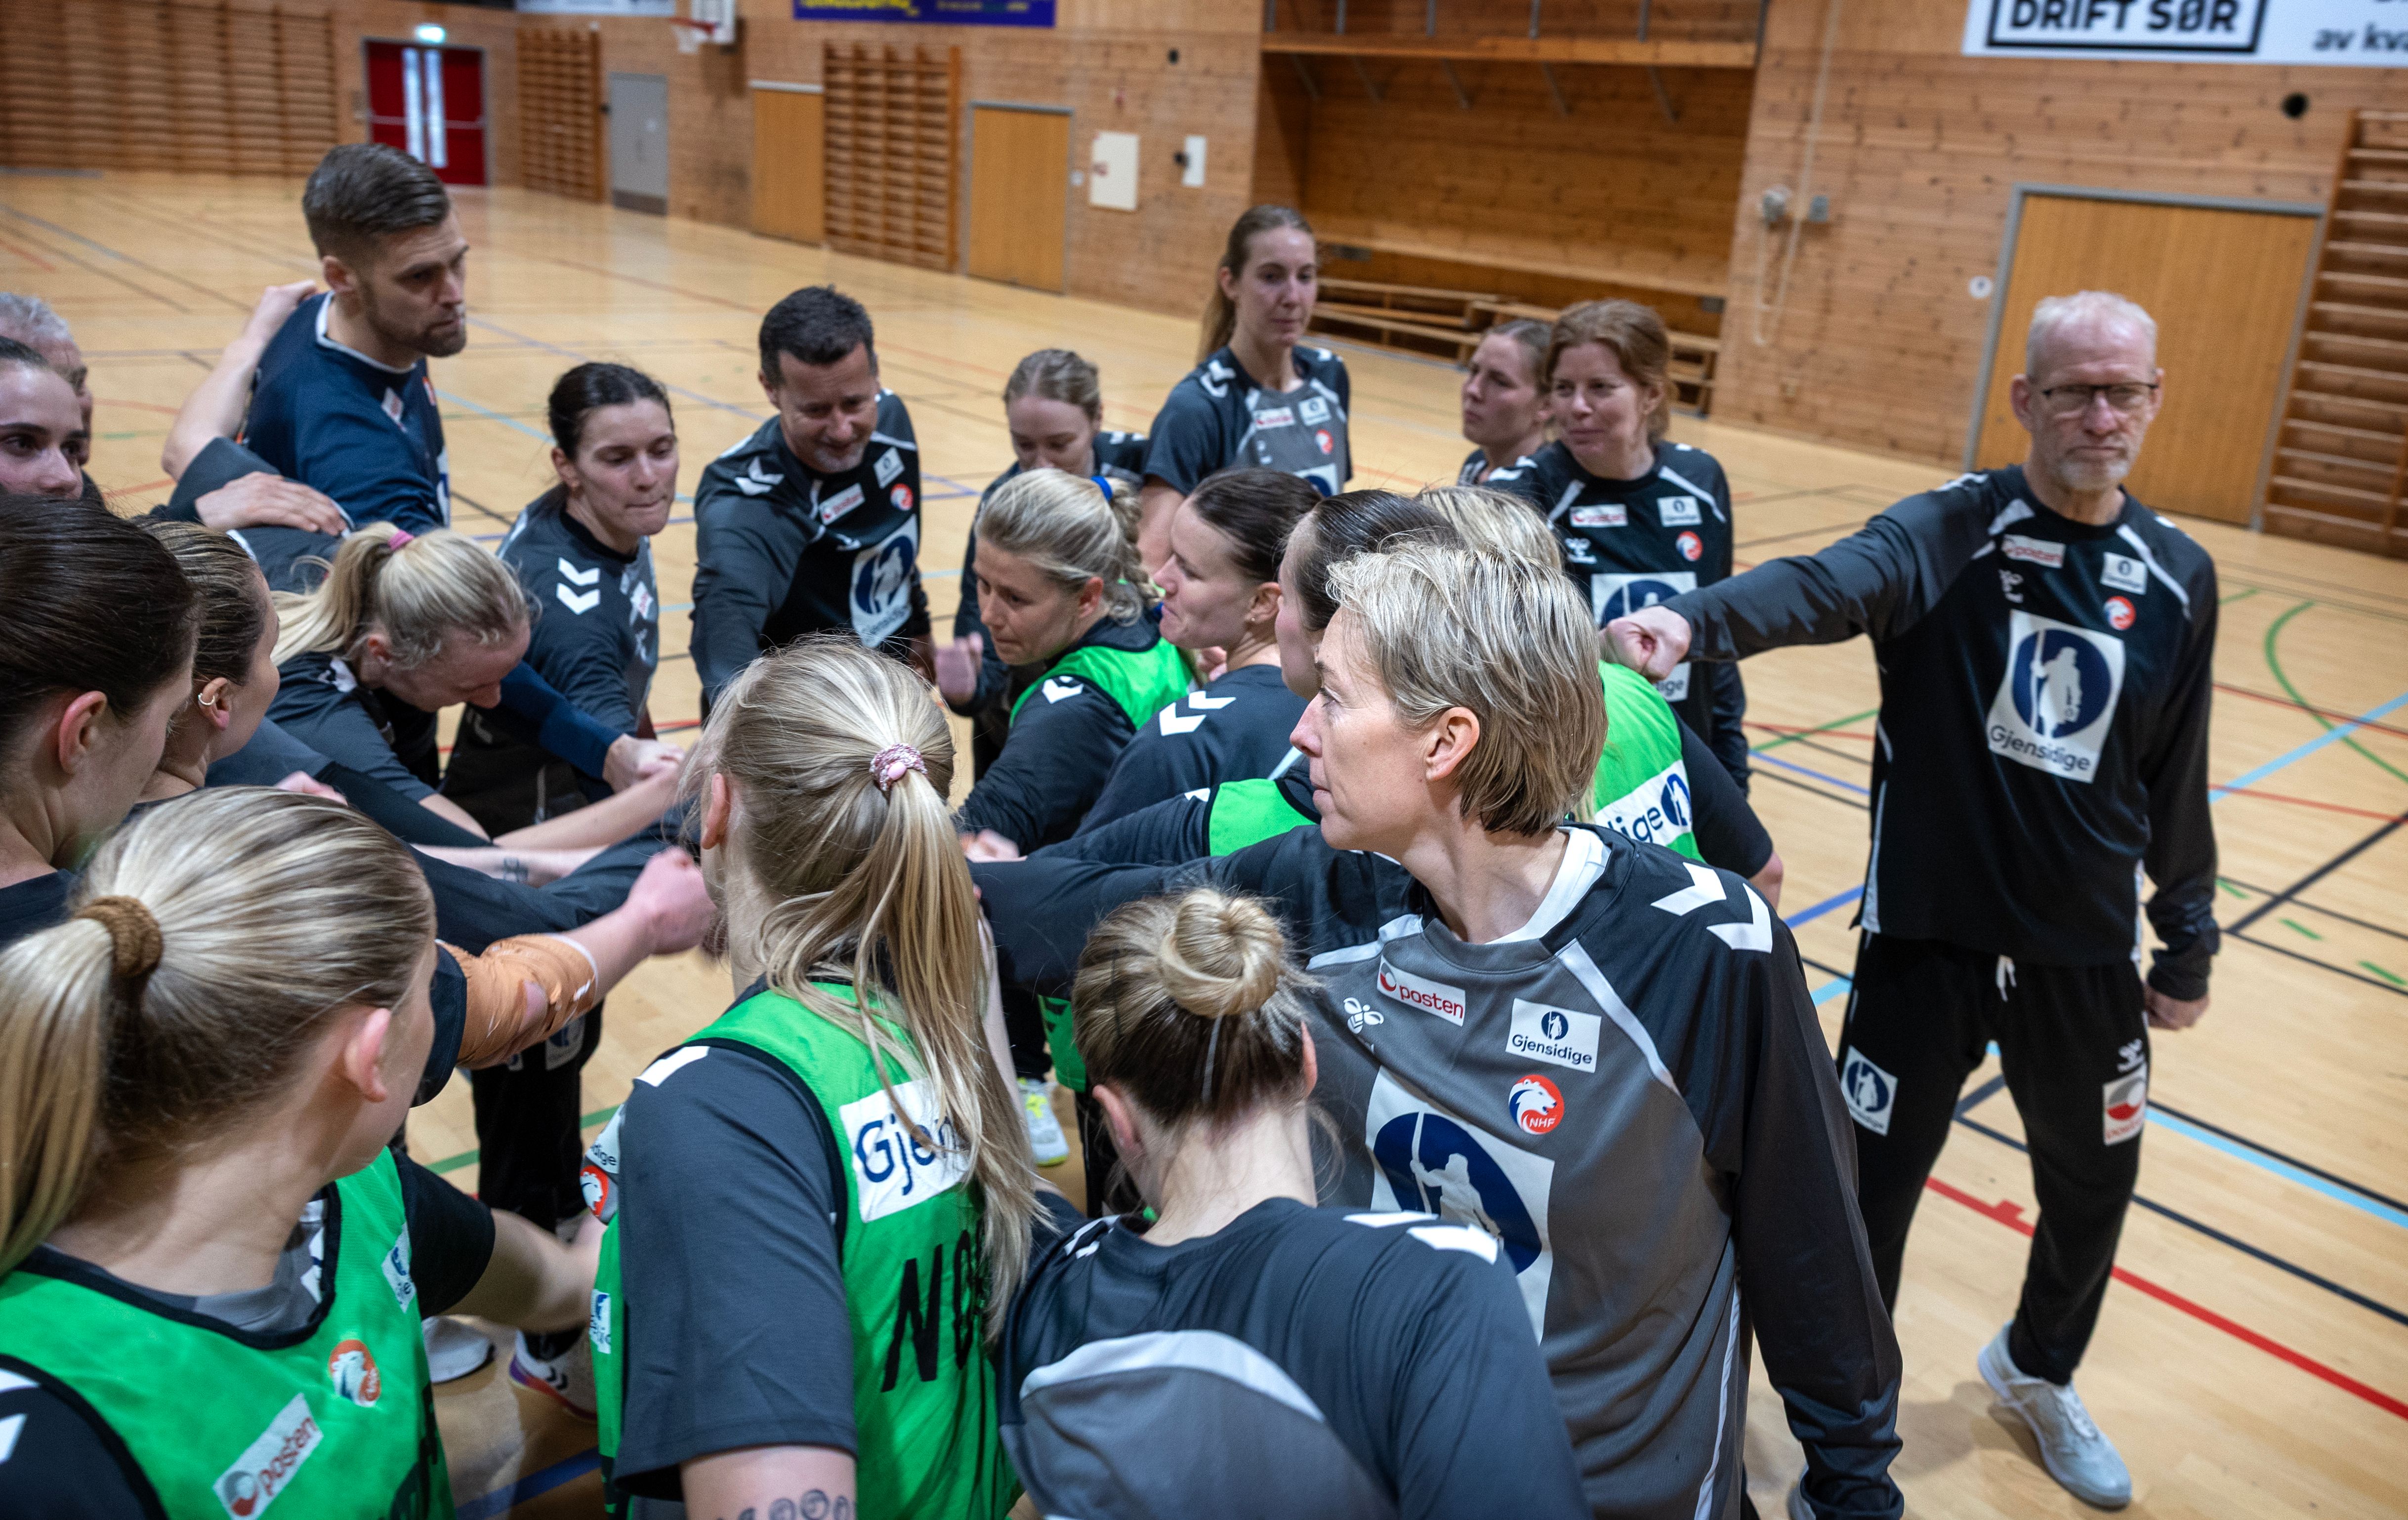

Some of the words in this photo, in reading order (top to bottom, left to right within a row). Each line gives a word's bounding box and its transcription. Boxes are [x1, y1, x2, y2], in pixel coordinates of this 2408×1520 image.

[2010, 0, 2137, 30] DRIFT
[2147, 0, 2235, 32] SØR
[1399, 986, 1463, 1019] posten
[1512, 1033, 1592, 1065] Gjensidige
[1530, 1117, 1556, 1128] NHF
[258, 1417, 318, 1497] posten
